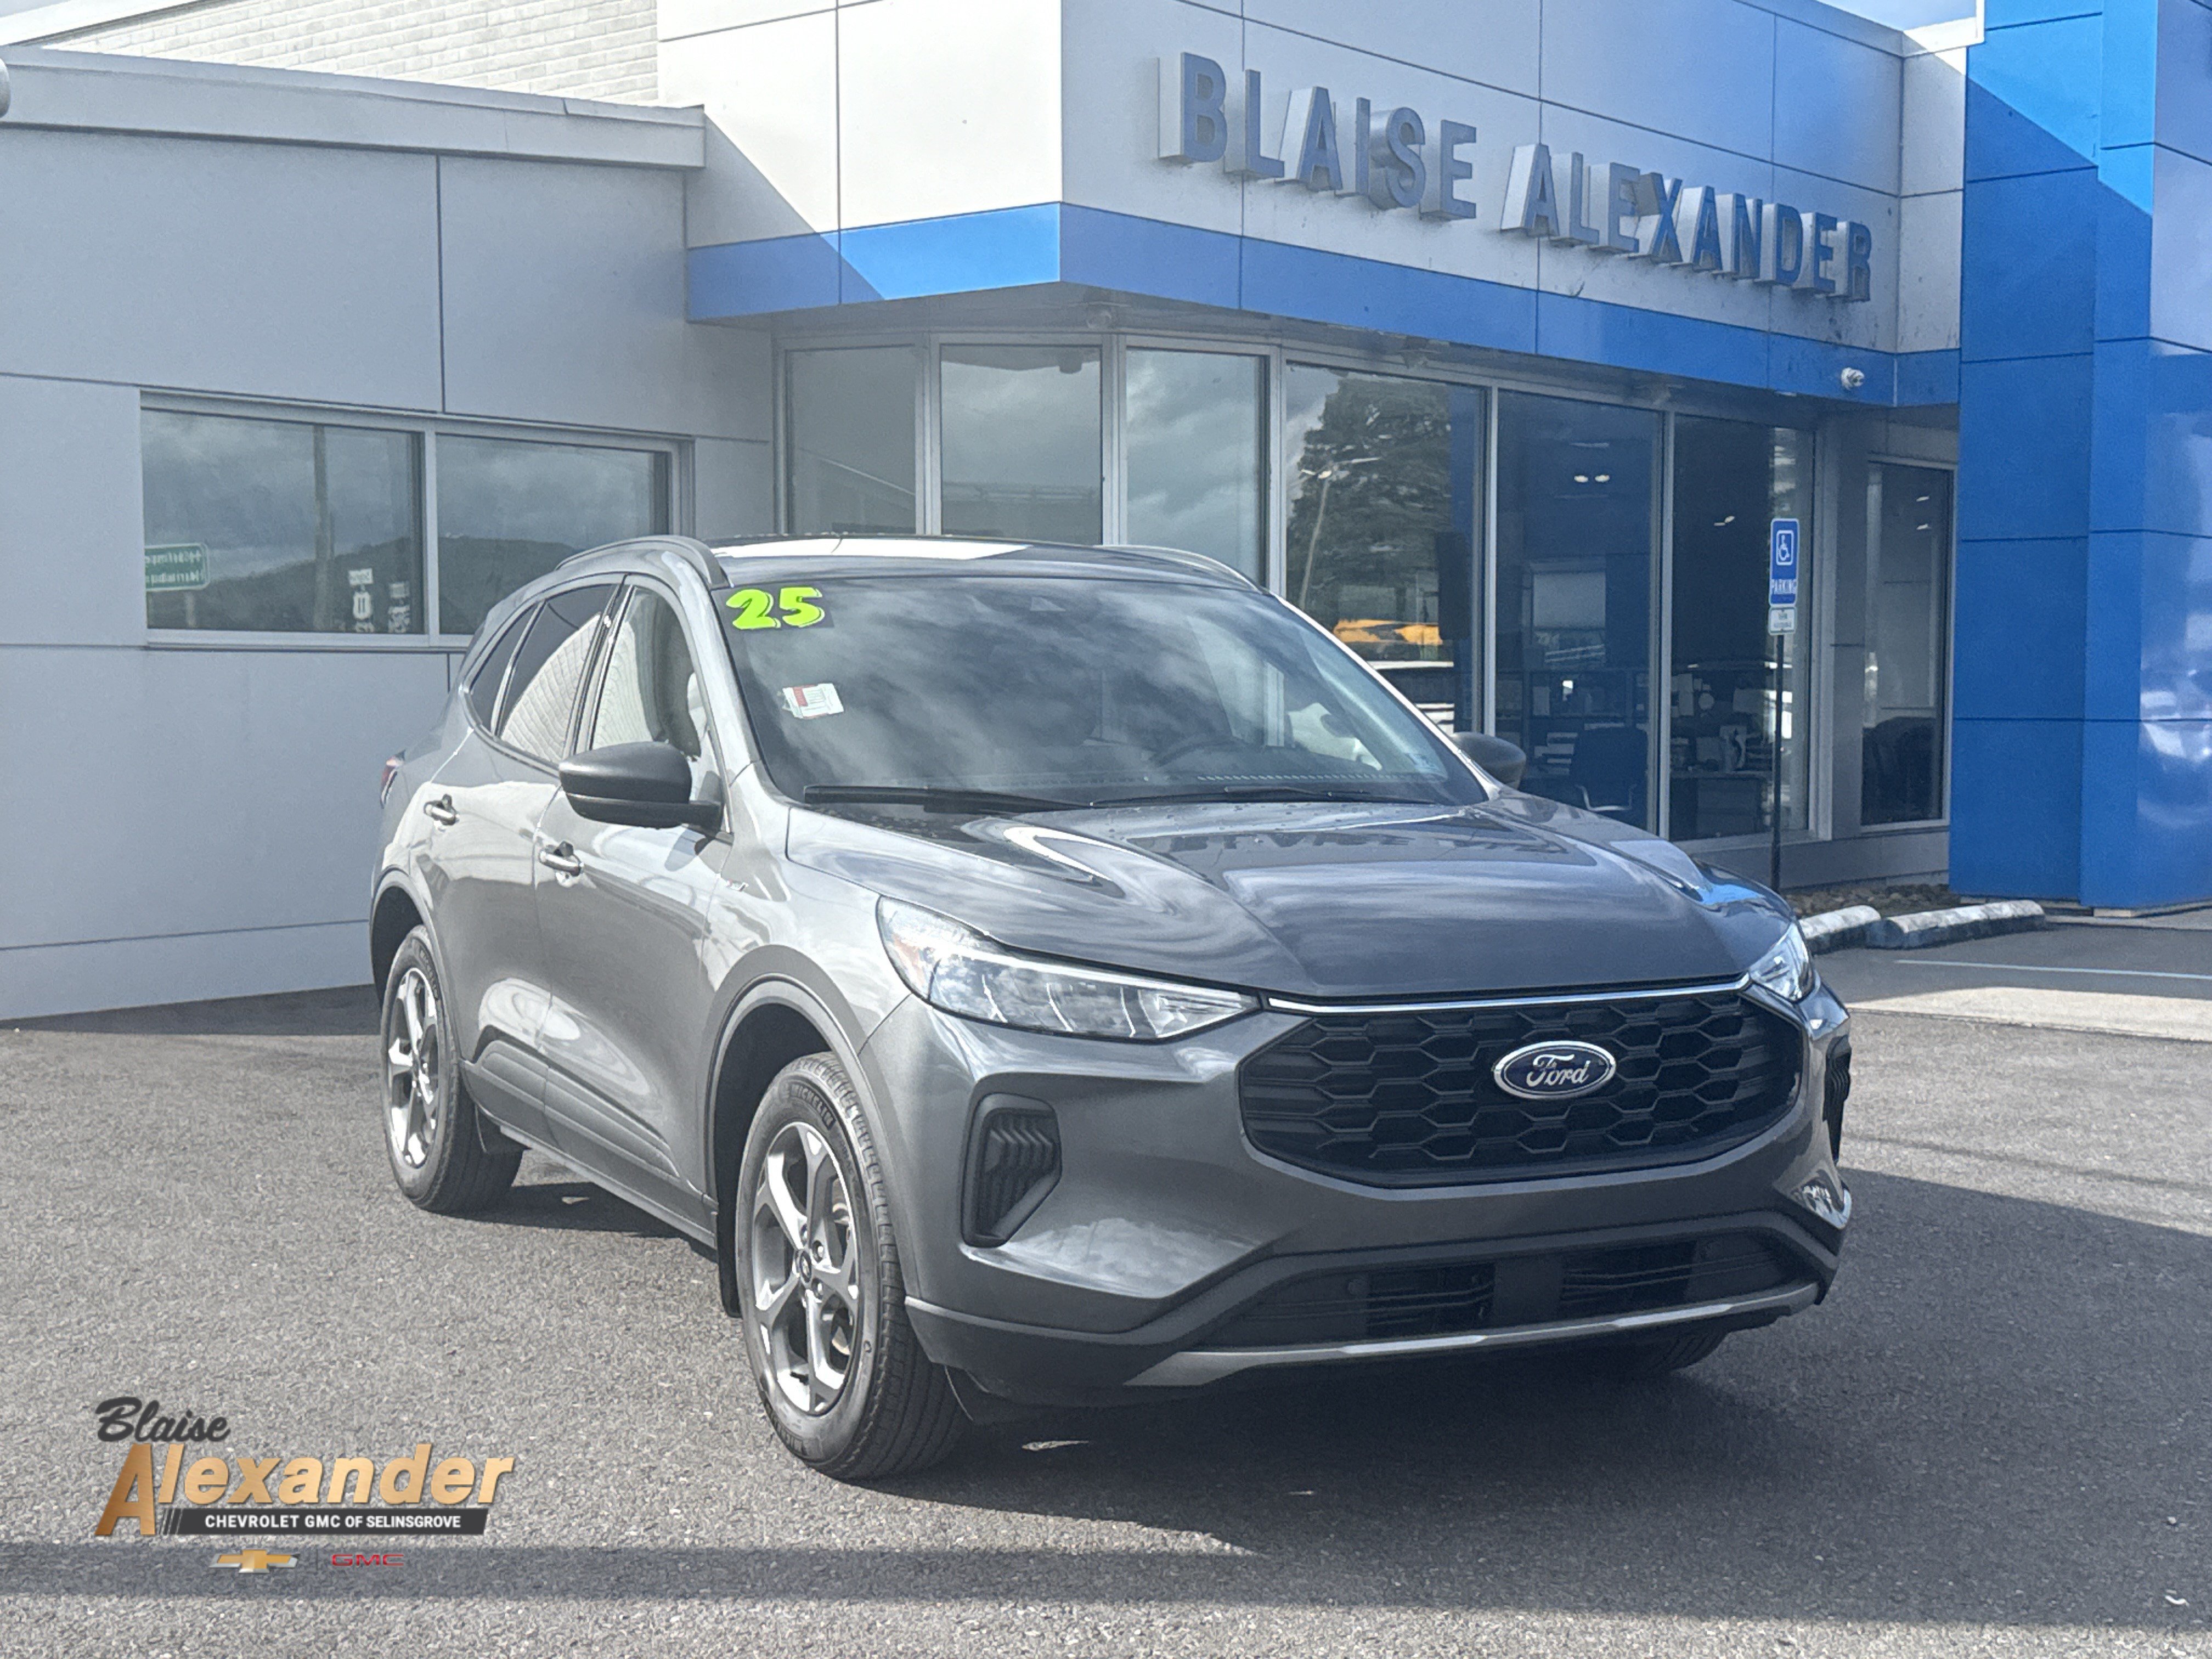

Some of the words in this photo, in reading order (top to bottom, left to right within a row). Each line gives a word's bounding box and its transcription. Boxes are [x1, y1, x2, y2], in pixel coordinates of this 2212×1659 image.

[1180, 51, 1477, 220] BLAISE
[1521, 143, 1873, 301] ALEXANDER
[726, 587, 825, 630] 25
[1526, 1053, 1591, 1087] Ford
[791, 1083, 835, 1127] MICHELIN
